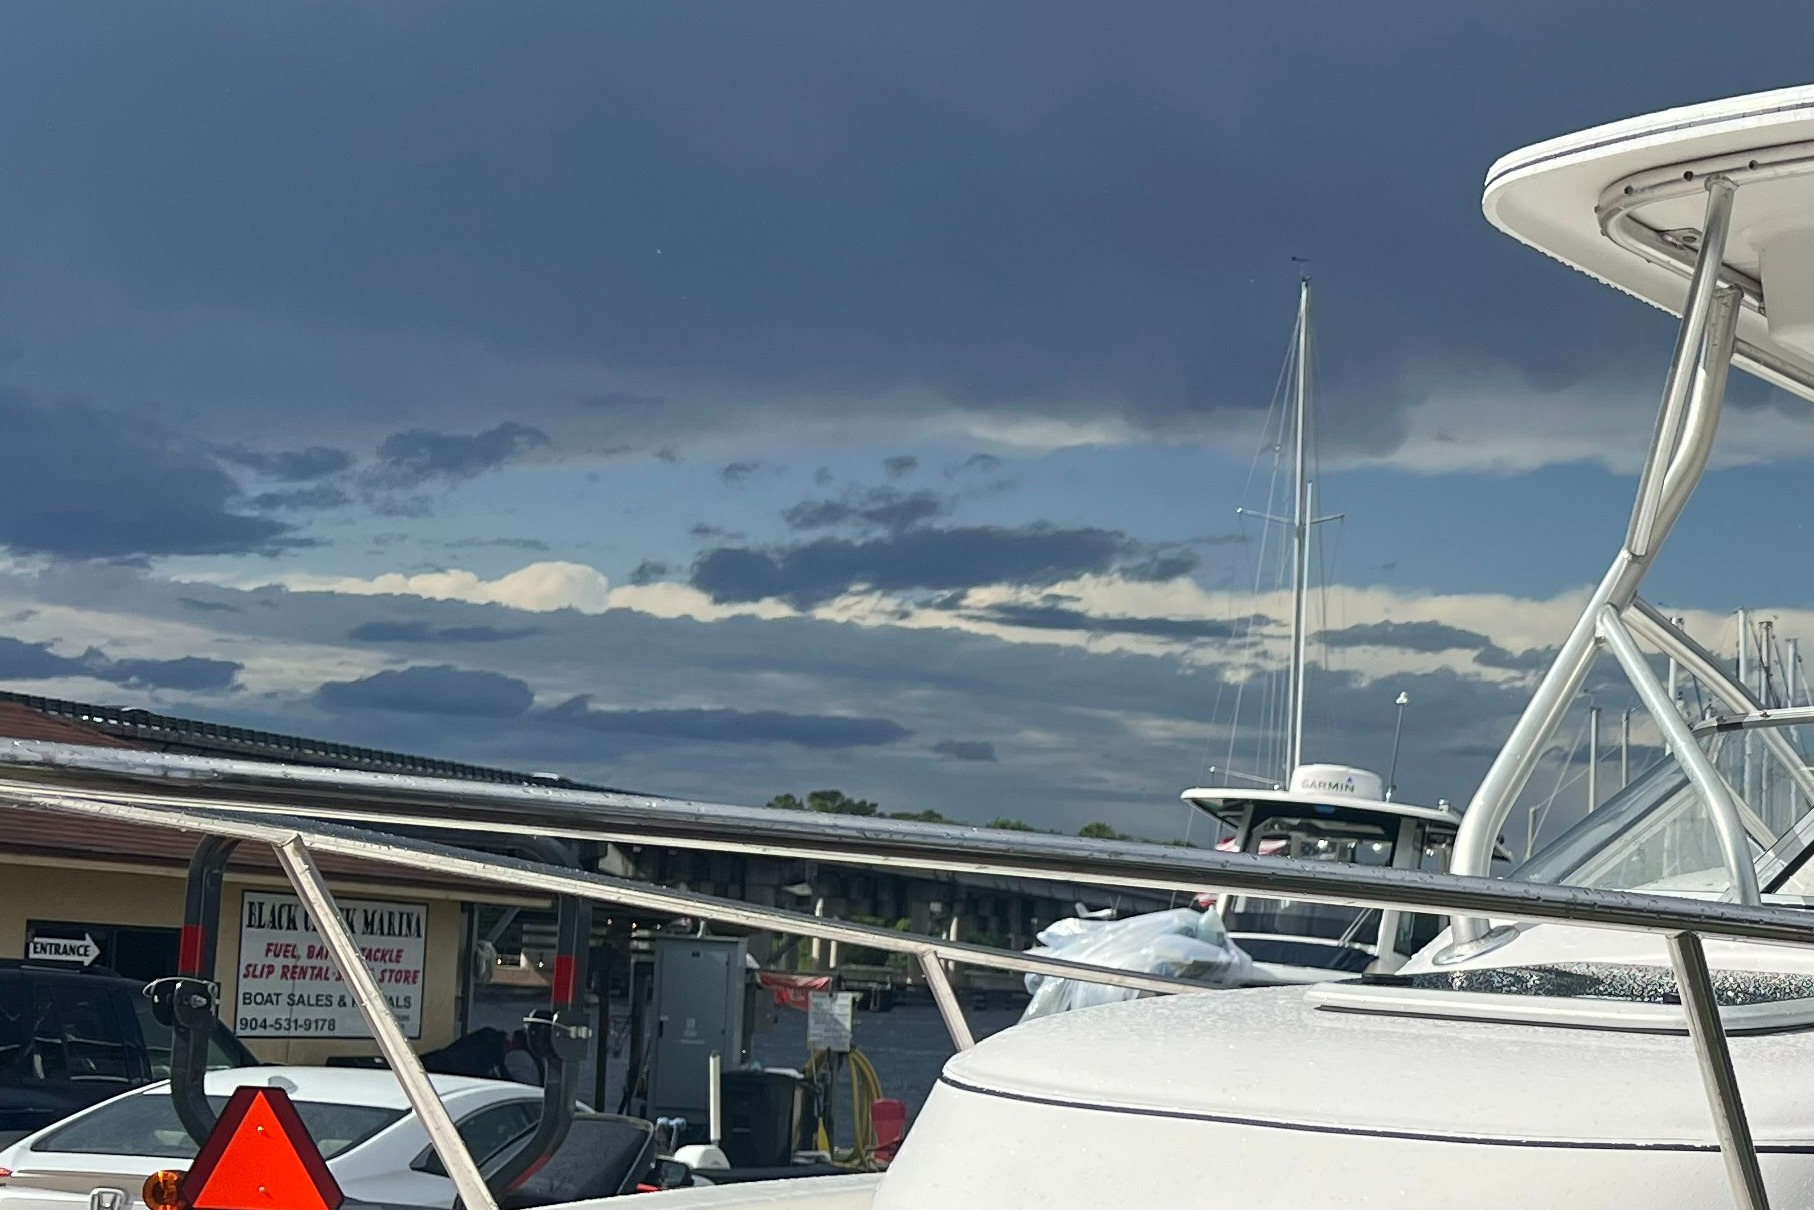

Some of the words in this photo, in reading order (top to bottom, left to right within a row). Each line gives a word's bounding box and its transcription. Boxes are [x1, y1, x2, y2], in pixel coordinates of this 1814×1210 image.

[1301, 778, 1355, 793] GARMIN
[246, 901, 298, 931] BLACK
[361, 908, 422, 938] MARINA
[33, 942, 91, 957] ENTRANCE
[307, 944, 329, 960] BAI
[243, 964, 275, 980] SLIP
[280, 965, 330, 982] RENTAL
[379, 968, 420, 985] STORE
[242, 992, 283, 1006] BOAT
[287, 993, 333, 1008] SALES
[338, 994, 347, 1008] &
[239, 1017, 336, 1032] 904-531-9178
